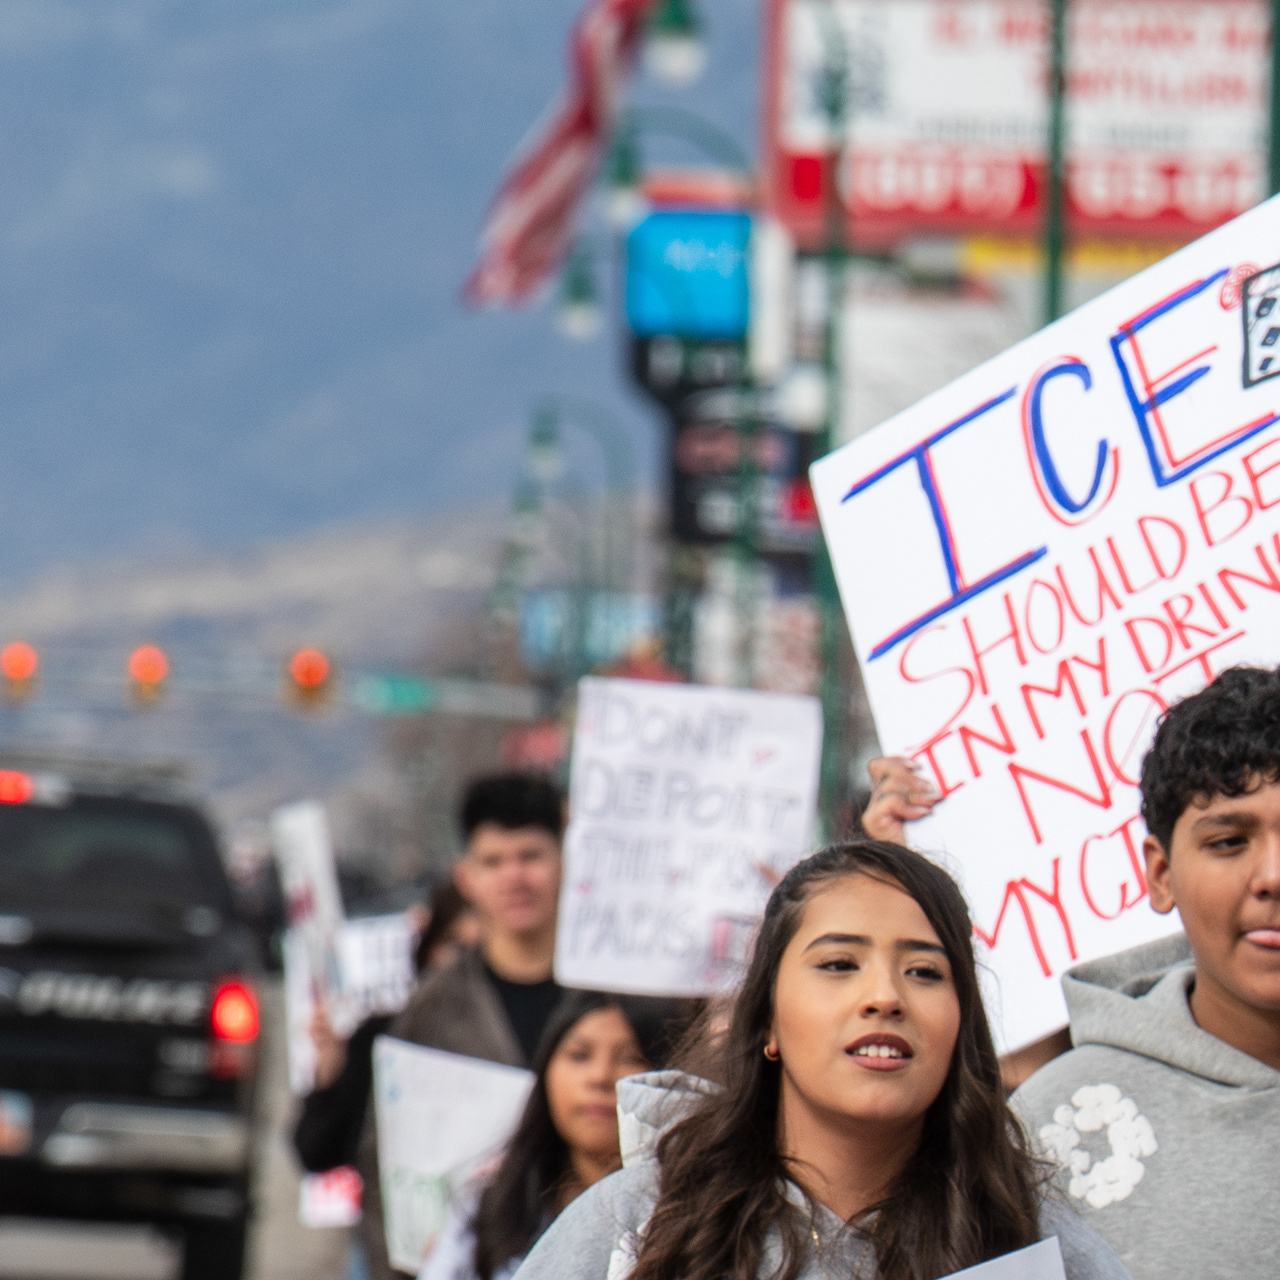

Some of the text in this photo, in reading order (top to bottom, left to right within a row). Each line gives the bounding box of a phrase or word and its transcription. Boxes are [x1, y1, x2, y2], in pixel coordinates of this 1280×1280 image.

[899, 515, 1187, 752] SHOULD
[910, 705, 1016, 799] IN
[1021, 637, 1110, 740] MY
